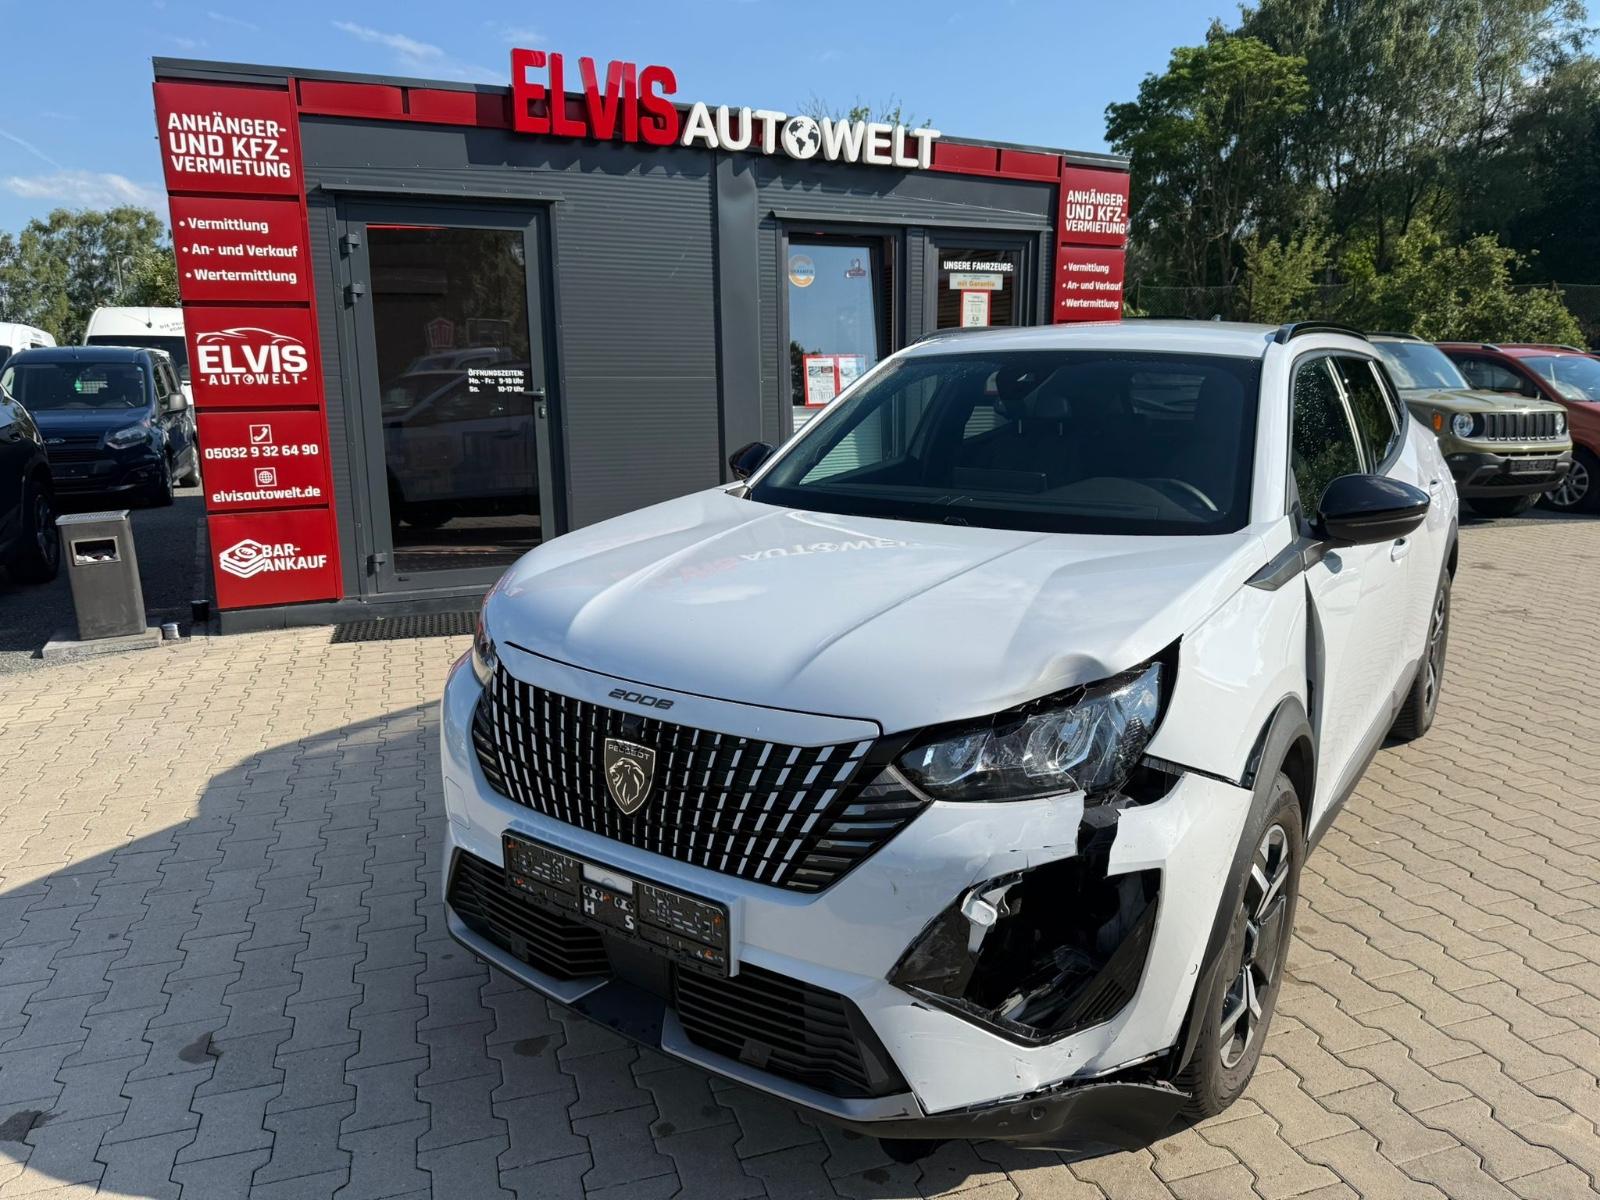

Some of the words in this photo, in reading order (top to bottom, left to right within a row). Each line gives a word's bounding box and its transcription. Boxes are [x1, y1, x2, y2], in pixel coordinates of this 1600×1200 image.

[511, 47, 679, 146] ELVIS
[168, 112, 287, 138] ANHÄNGER-
[169, 132, 224, 157] UND
[232, 137, 288, 160] KFZ-
[171, 155, 291, 178] VERMIETUNG
[1067, 188, 1126, 206] ANHÄNGER-
[1066, 204, 1094, 220] UND
[1097, 206, 1126, 222] KFZ-
[188, 217, 269, 234] Vermittlung
[1065, 219, 1126, 235] VERMIETUNG
[192, 243, 214, 255] An-
[219, 243, 243, 256] und
[247, 244, 298, 258] Verkauf
[943, 260, 971, 270] UNSERE
[972, 261, 1014, 272] FAHRZEUGE:
[1068, 262, 1109, 273] Vermittlung
[194, 269, 297, 285] Wertermittlung
[1067, 280, 1079, 290] An-
[1081, 280, 1094, 290] und
[1095, 281, 1122, 291] Verkauf
[1066, 299, 1119, 310] Wertermittlung
[197, 345, 308, 373] ELVIS
[468, 368, 524, 376] ÖFFNUNGSZEITEN:
[205, 447, 248, 459] 05032
[251, 447, 259, 458] 9
[262, 446, 279, 457] 32
[282, 445, 299, 456] 64
[301, 444, 318, 455] 90
[212, 485, 321, 503] elvisautowelt.de
[263, 543, 301, 558] BAR-
[263, 554, 327, 571] ANKAUF
[608, 688, 674, 710] 2008
[608, 744, 650, 760] PEUGEOT
